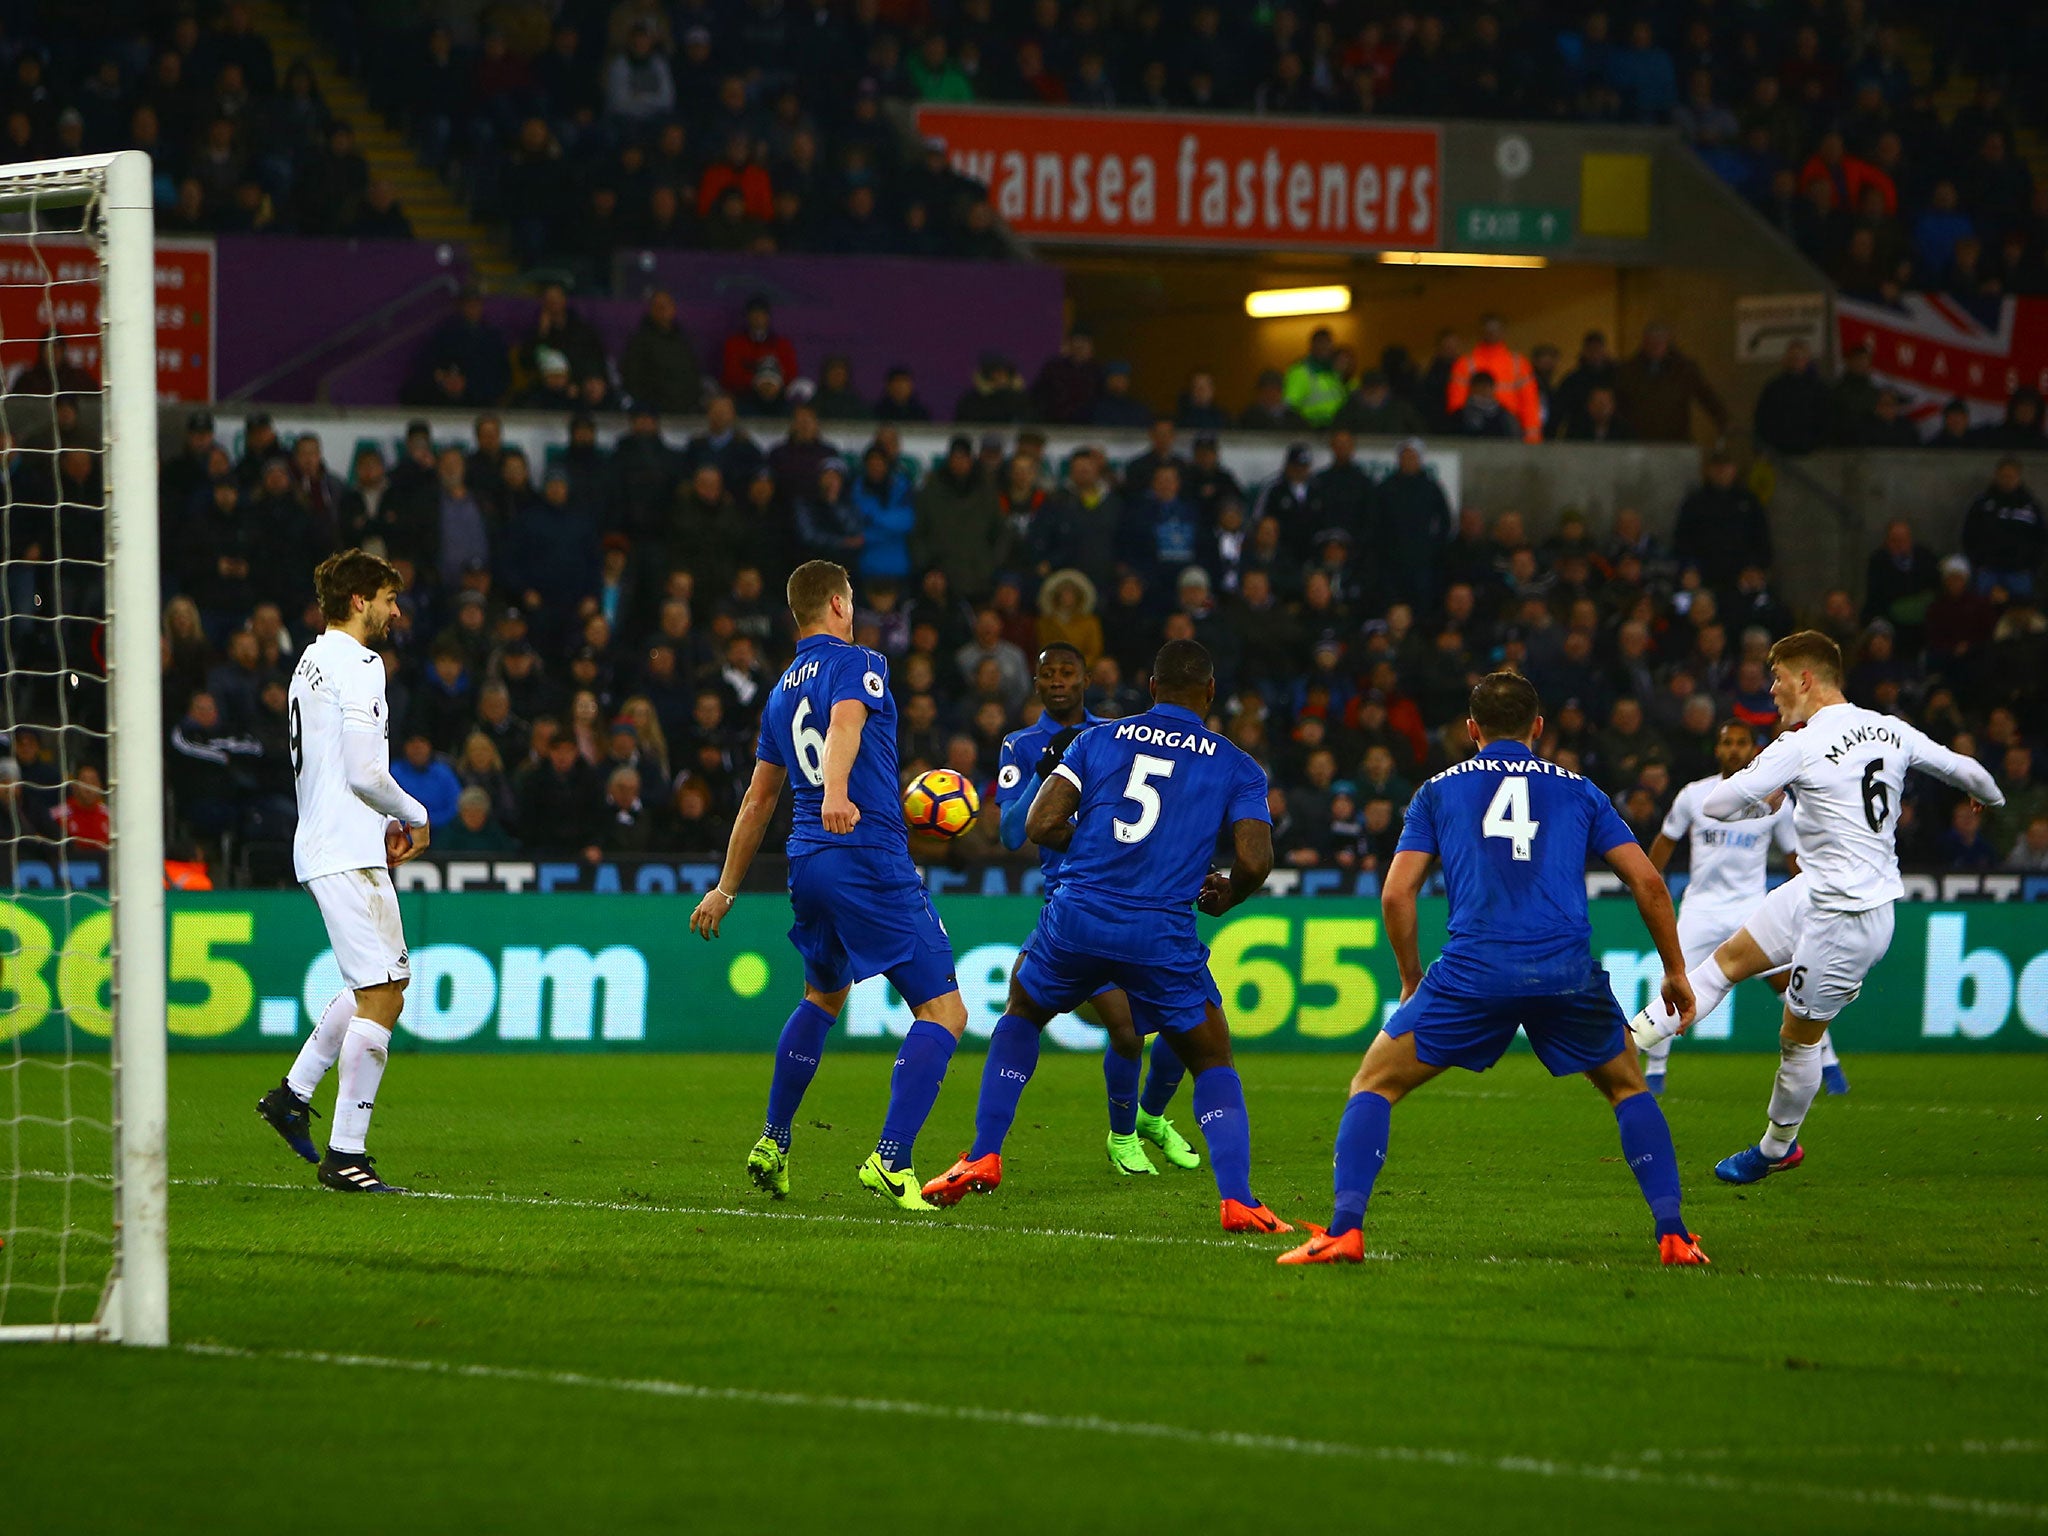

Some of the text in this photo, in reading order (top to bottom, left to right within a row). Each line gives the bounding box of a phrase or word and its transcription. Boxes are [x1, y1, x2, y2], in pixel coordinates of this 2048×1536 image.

[948, 150, 1157, 225] ansea
[1177, 133, 1433, 234] fasteners
[782, 660, 820, 692] HUTH
[290, 696, 303, 778] 9
[791, 696, 826, 788] 6
[1114, 723, 1217, 756] MORGAN
[1824, 724, 1902, 766] MAWSON
[1430, 758, 1584, 784] DRINKWATER
[1112, 752, 1176, 845] 5
[1861, 757, 1890, 834] 6
[1481, 775, 1541, 862] 4
[1791, 965, 1808, 992] 6
[788, 1050, 817, 1066] LCFC
[1000, 1068, 1027, 1083] LCFC
